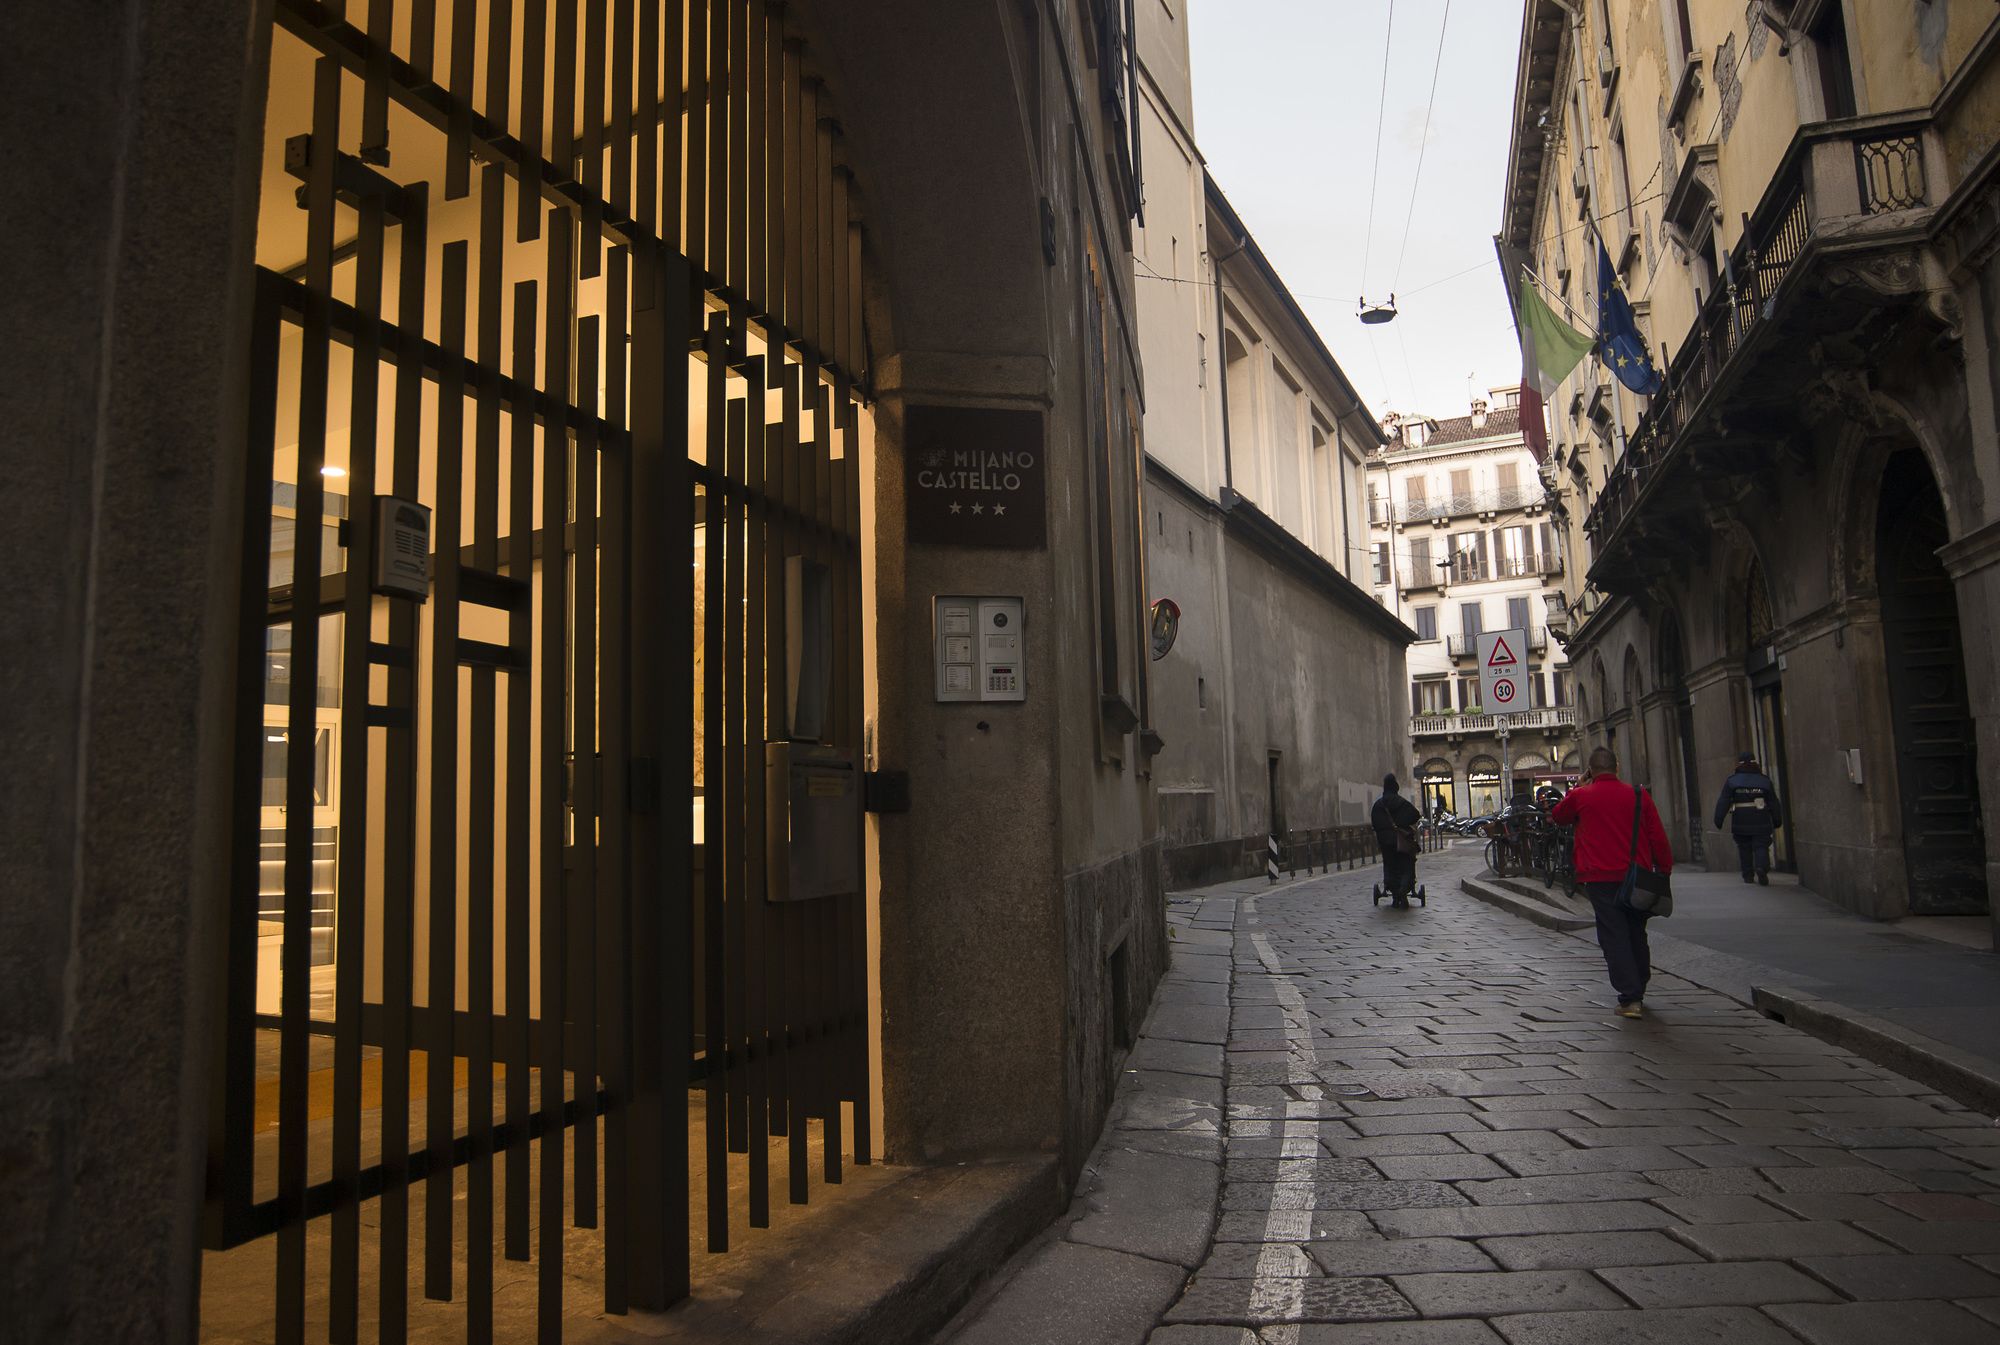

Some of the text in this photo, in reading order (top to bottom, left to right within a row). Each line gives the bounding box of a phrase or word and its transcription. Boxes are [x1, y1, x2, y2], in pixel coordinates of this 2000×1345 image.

[953, 450, 1035, 471] MILANO
[917, 470, 1021, 490] CASTELLO
[1493, 667, 1503, 675] 25
[1497, 684, 1511, 697] 30
